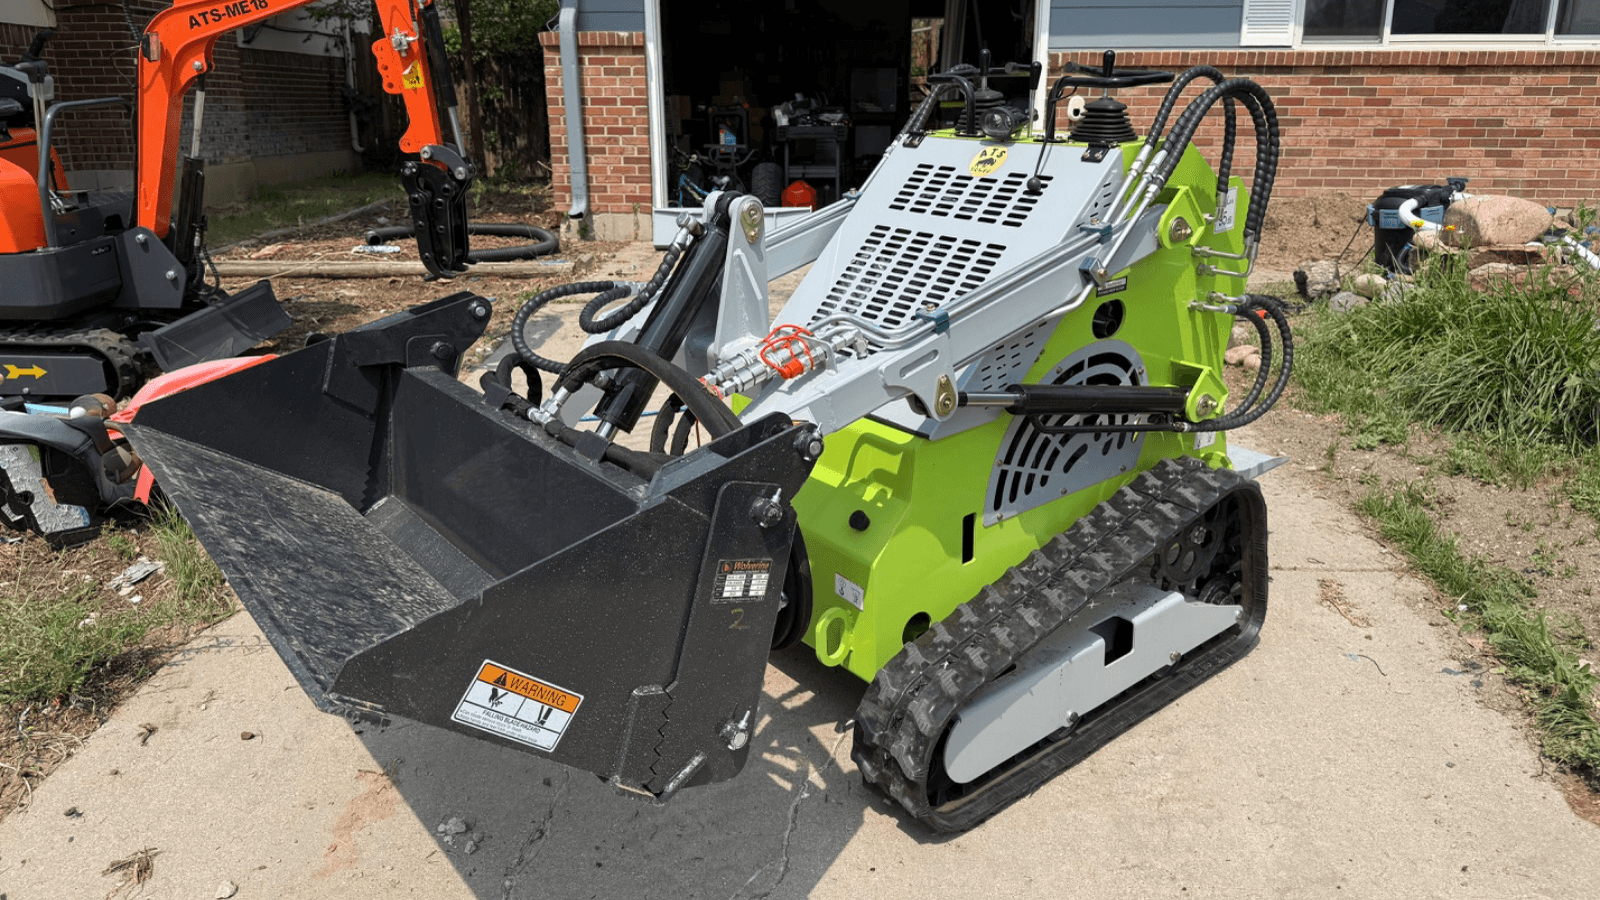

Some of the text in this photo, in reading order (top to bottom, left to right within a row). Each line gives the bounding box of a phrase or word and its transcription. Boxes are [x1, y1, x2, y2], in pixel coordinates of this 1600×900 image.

[189, 0, 268, 29] ATS-ME18
[980, 148, 1006, 158] ATS
[729, 608, 749, 629] 2
[510, 676, 567, 706] WARNING
[482, 709, 504, 722] FALLING
[504, 716, 521, 728] BLADE
[520, 722, 541, 734] HAZARD
